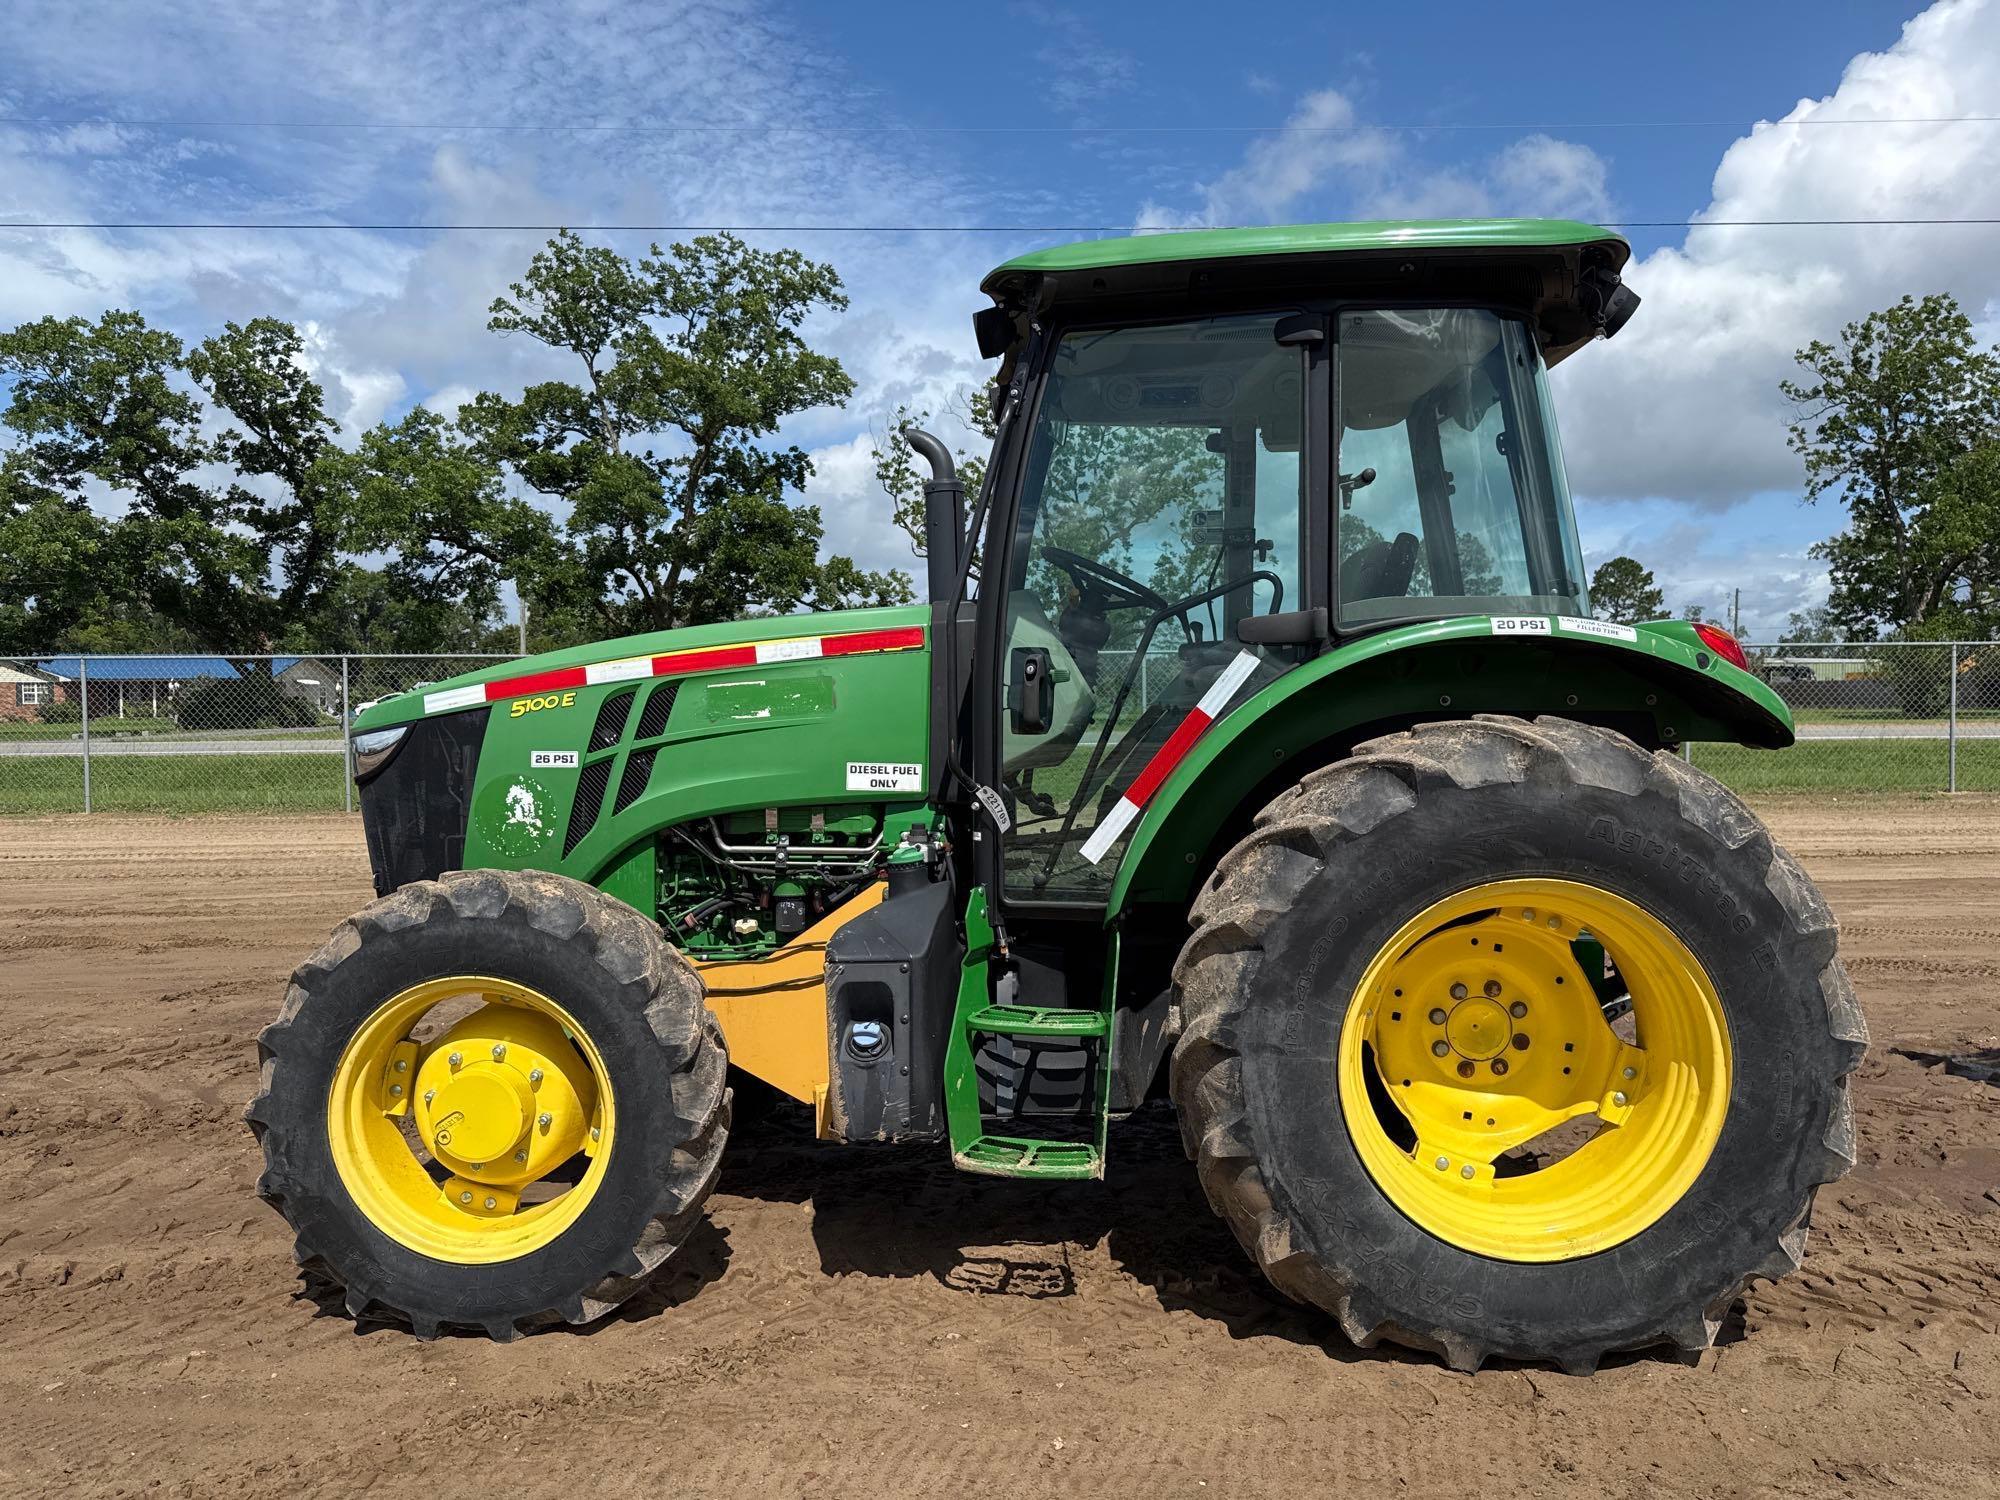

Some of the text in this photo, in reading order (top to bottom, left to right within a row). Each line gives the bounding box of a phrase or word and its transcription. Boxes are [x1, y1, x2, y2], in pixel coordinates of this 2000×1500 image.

[1497, 620, 1547, 630] 20 PSI
[1577, 625, 1601, 633] FILLED
[510, 695, 560, 718] 5100
[535, 754, 575, 764] 26 PSI
[850, 765, 919, 776] DIESEL FUEL
[870, 779, 898, 788] ONLY
[986, 793, 1008, 826] 221705
[1584, 816, 1753, 935] AgriTrac
[1299, 1176, 1485, 1320] GALAXY
